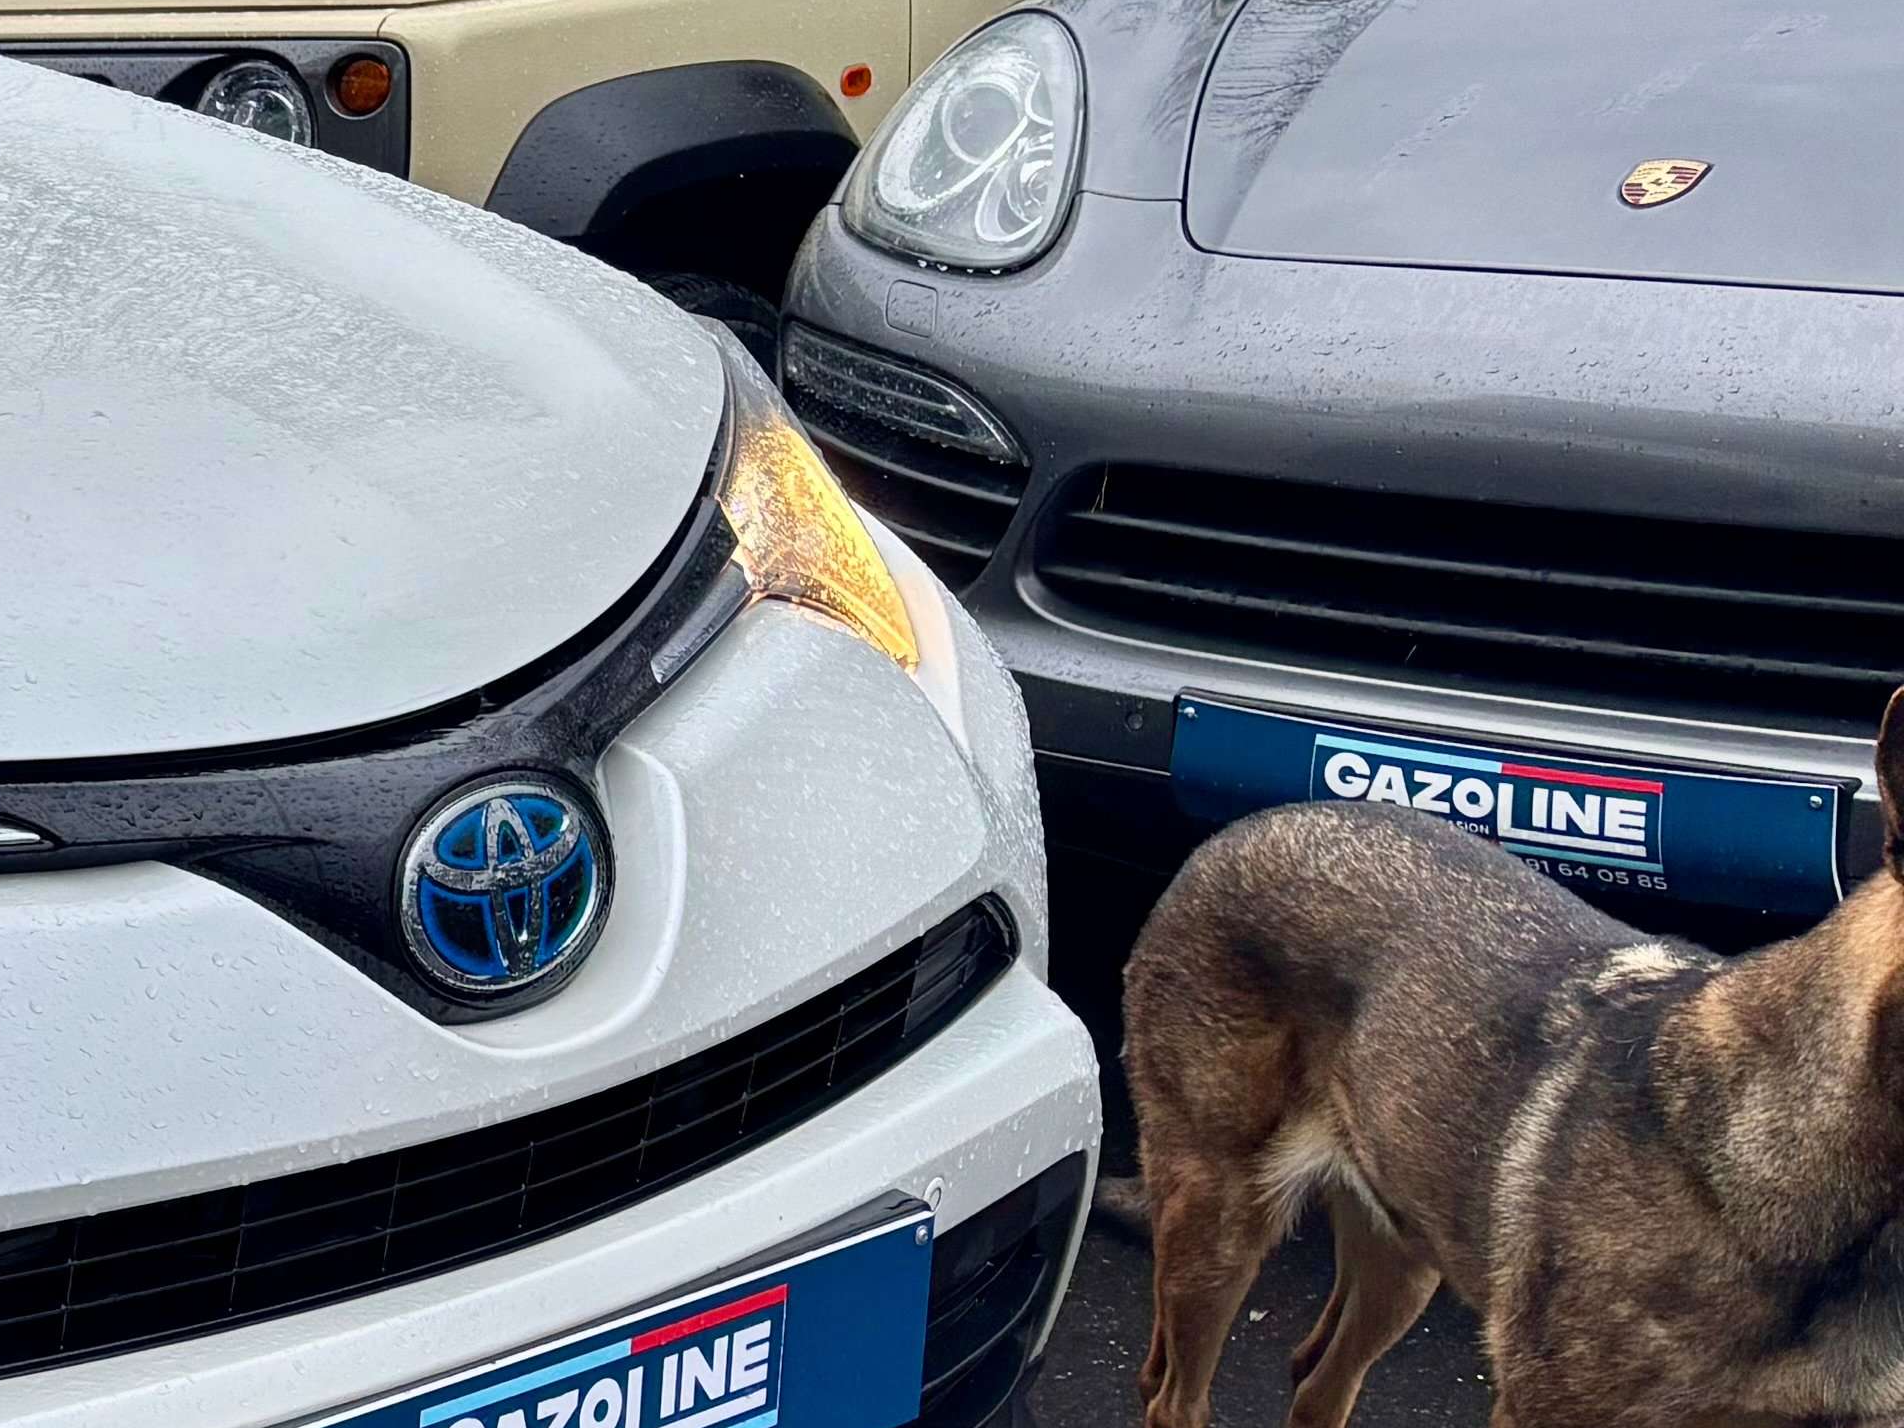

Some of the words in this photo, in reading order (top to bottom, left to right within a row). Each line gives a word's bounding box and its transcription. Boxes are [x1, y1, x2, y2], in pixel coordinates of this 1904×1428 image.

[1324, 752, 1647, 857] GAZOLINE
[1558, 863, 1589, 879] 64
[1597, 868, 1630, 885] 05
[1637, 874, 1668, 890] 85
